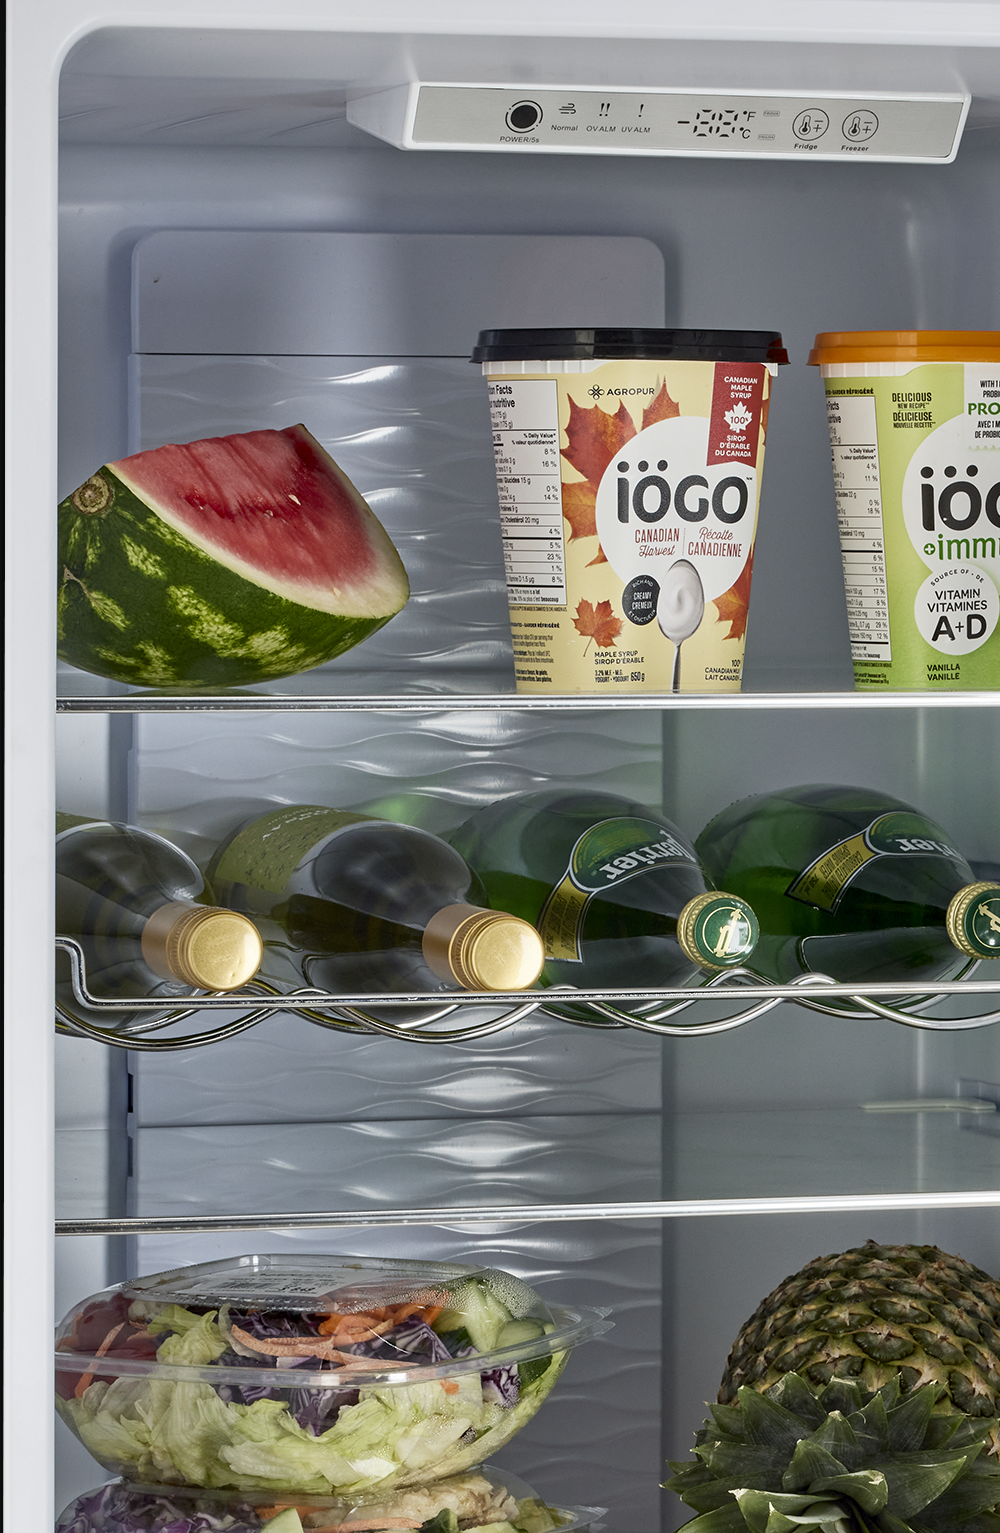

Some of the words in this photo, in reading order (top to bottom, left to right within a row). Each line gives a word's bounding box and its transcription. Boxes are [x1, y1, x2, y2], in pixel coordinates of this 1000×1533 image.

[724, 376, 758, 384] CANADIAN
[980, 380, 995, 388] WITH
[996, 380, 998, 388] 1
[607, 387, 655, 397] AGROPUR
[892, 392, 932, 402] DELICIOUS
[893, 410, 932, 421] DÉLICIEUSE
[720, 441, 750, 449] D'ÉRABLE
[635, 528, 680, 543] CANADIAN
[699, 527, 733, 544] Récolte
[639, 545, 676, 558] Harvest
[688, 542, 742, 557] CANADIENNE
[934, 588, 981, 600] VITAMIN
[927, 600, 988, 613] VITAMINES
[931, 614, 987, 642] A+D
[927, 663, 960, 672] VANILLA
[927, 672, 960, 681] VANILLE
